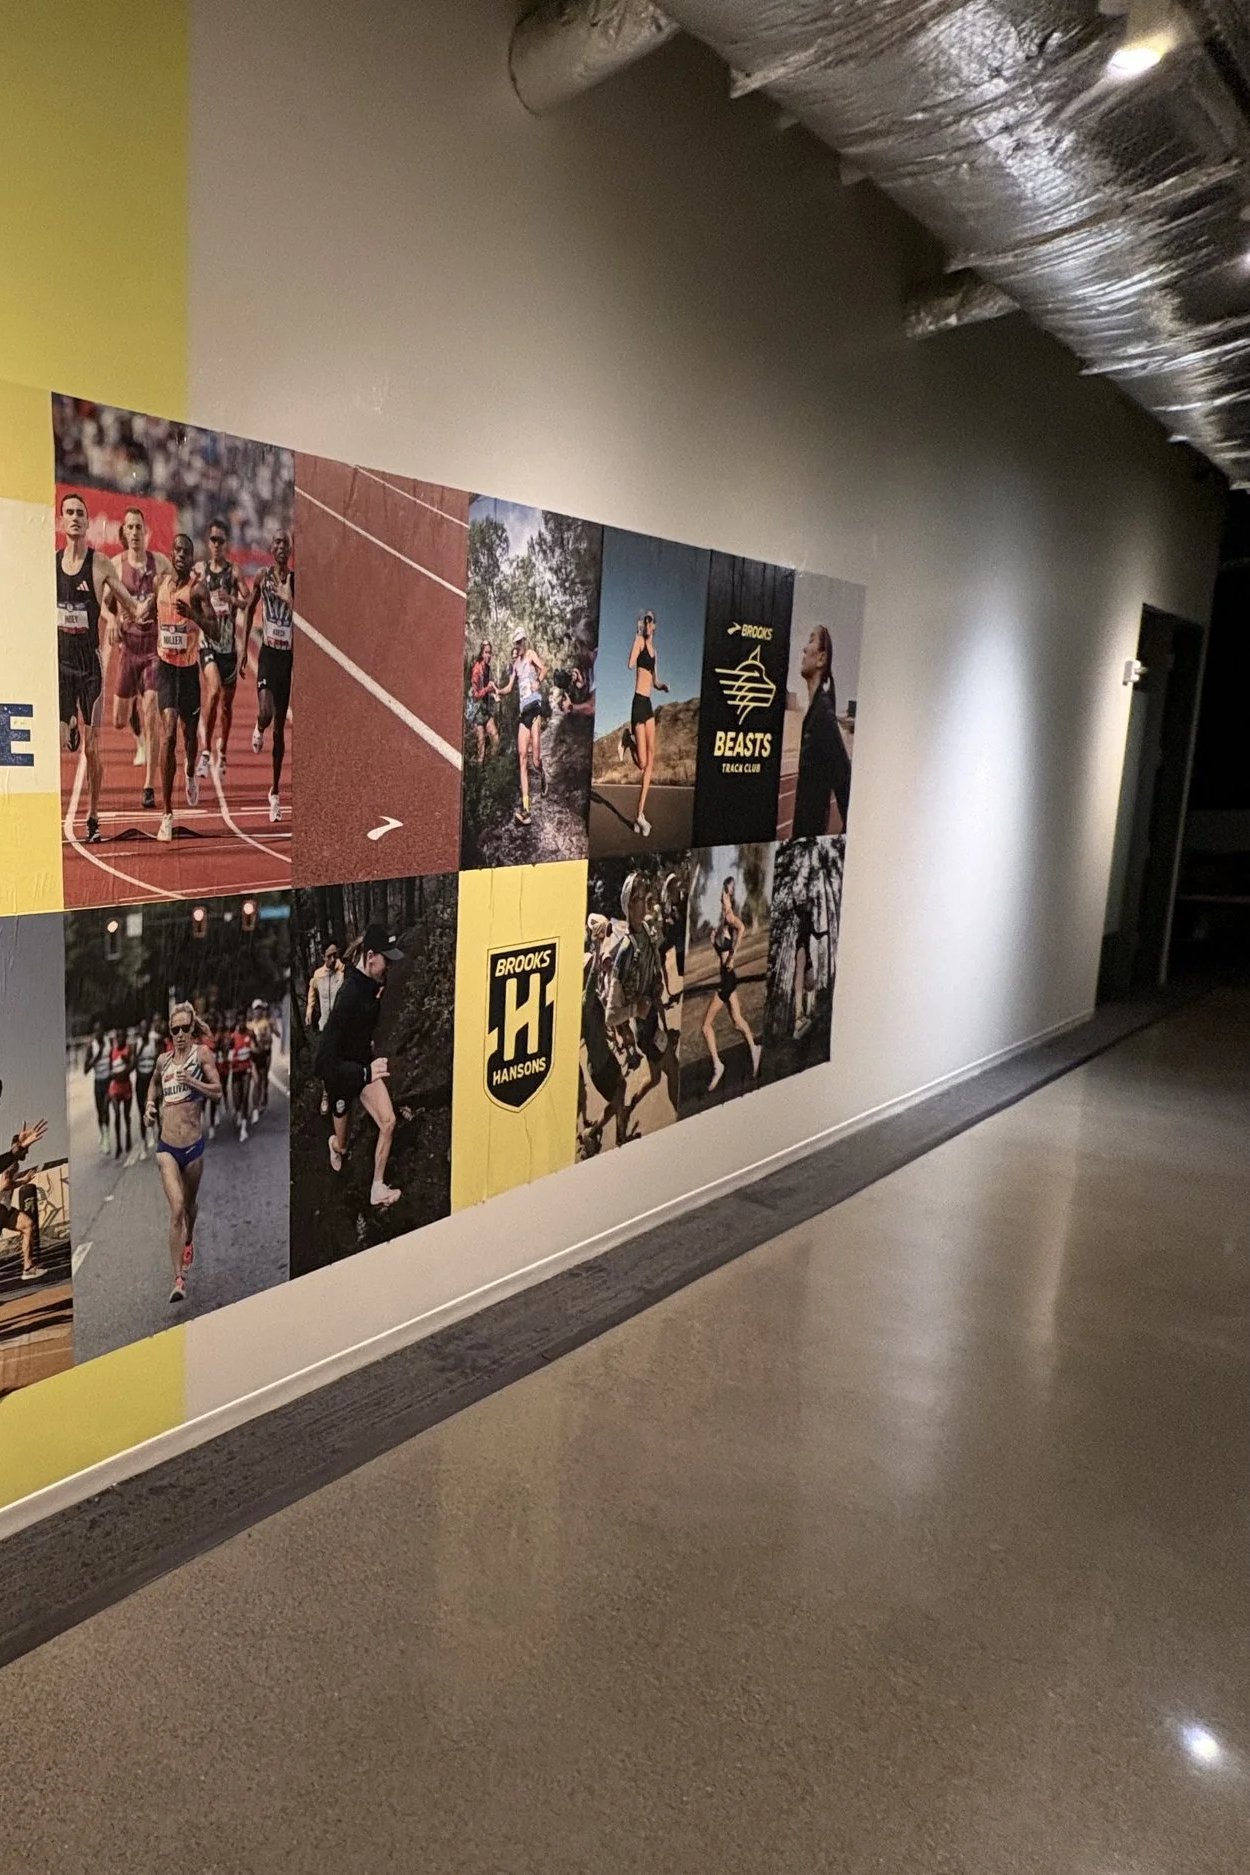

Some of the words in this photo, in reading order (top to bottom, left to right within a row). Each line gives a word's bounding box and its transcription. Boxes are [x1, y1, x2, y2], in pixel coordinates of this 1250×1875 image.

[163, 635, 183, 645] MILLER
[741, 623, 773, 641] BROOKS
[714, 730, 772, 758] BEASTS
[722, 762, 743, 774] TRACK
[743, 762, 761, 773] CLUB
[494, 950, 551, 977] BROOKS
[503, 972, 541, 1061] H
[492, 1057, 546, 1086] HANSONS
